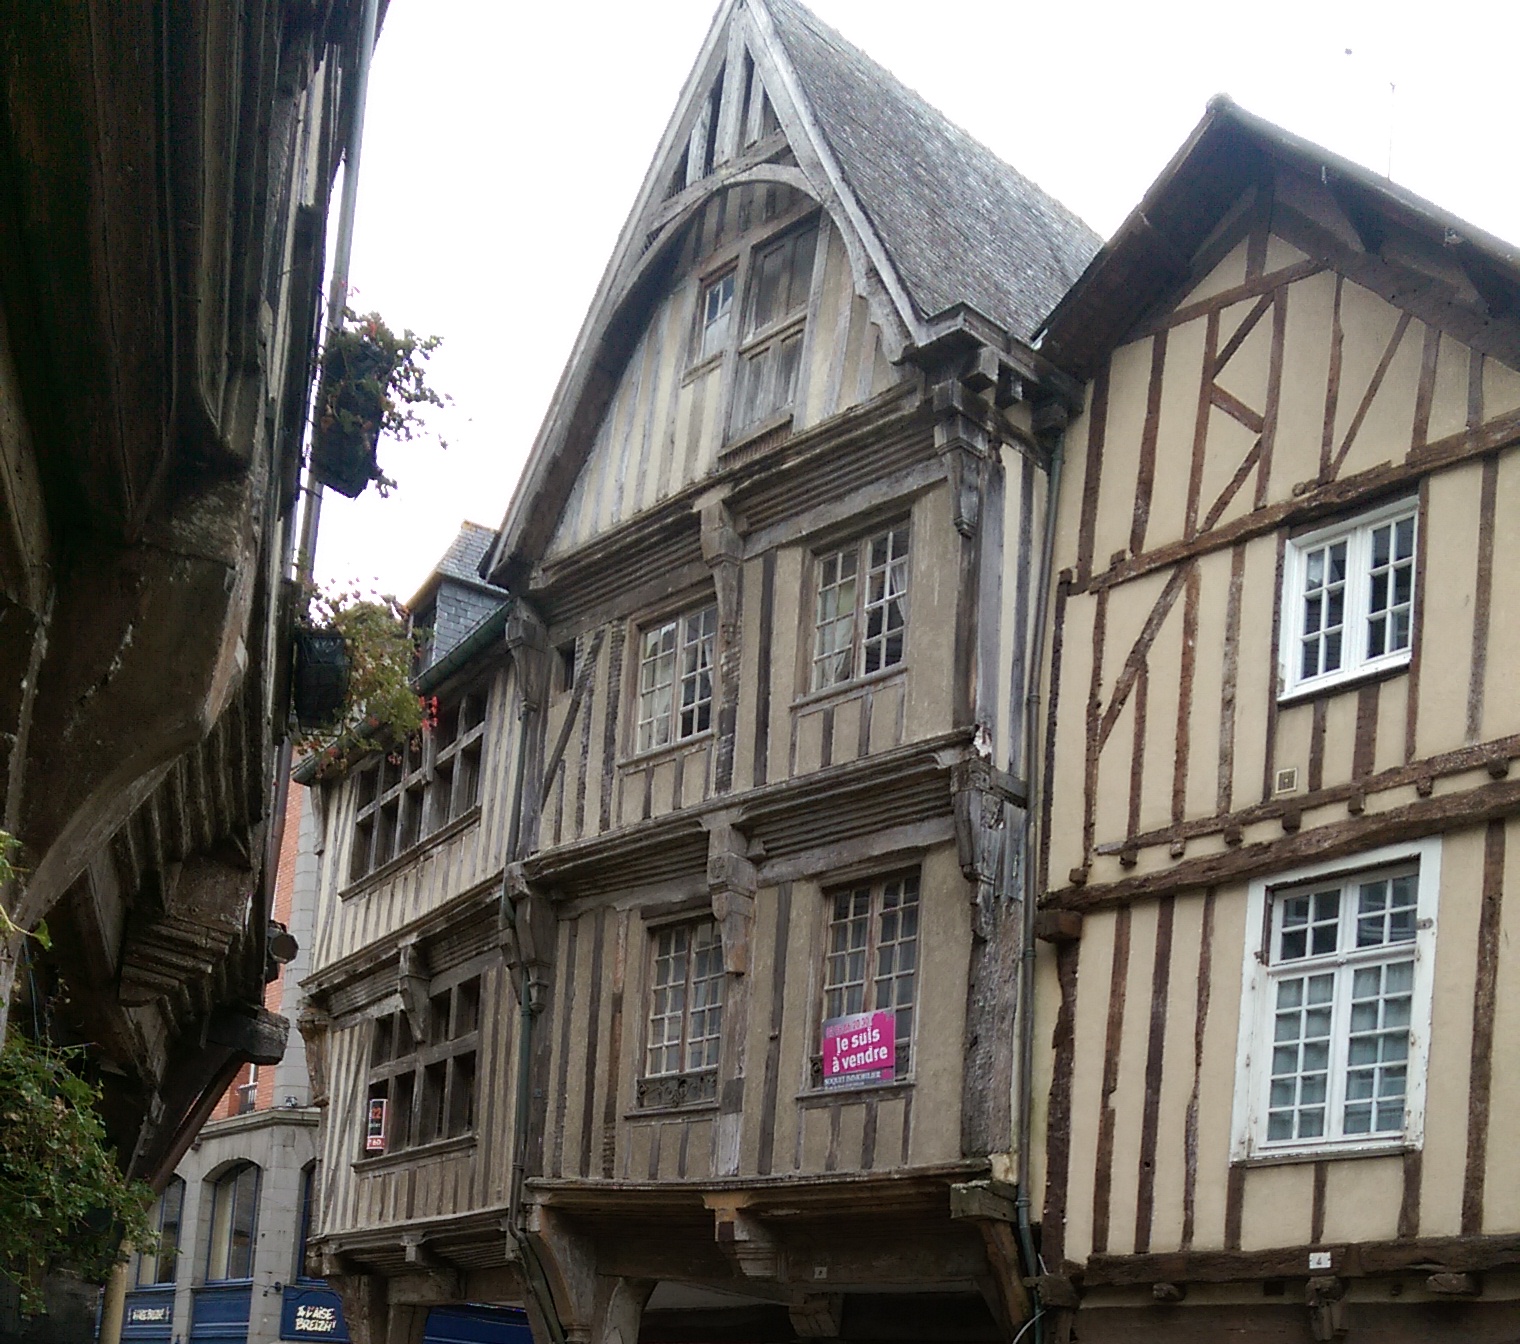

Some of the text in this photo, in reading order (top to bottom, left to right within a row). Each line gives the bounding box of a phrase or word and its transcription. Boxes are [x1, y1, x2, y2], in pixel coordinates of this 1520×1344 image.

[851, 1026, 880, 1048] suis
[832, 1045, 888, 1073] à vendre
